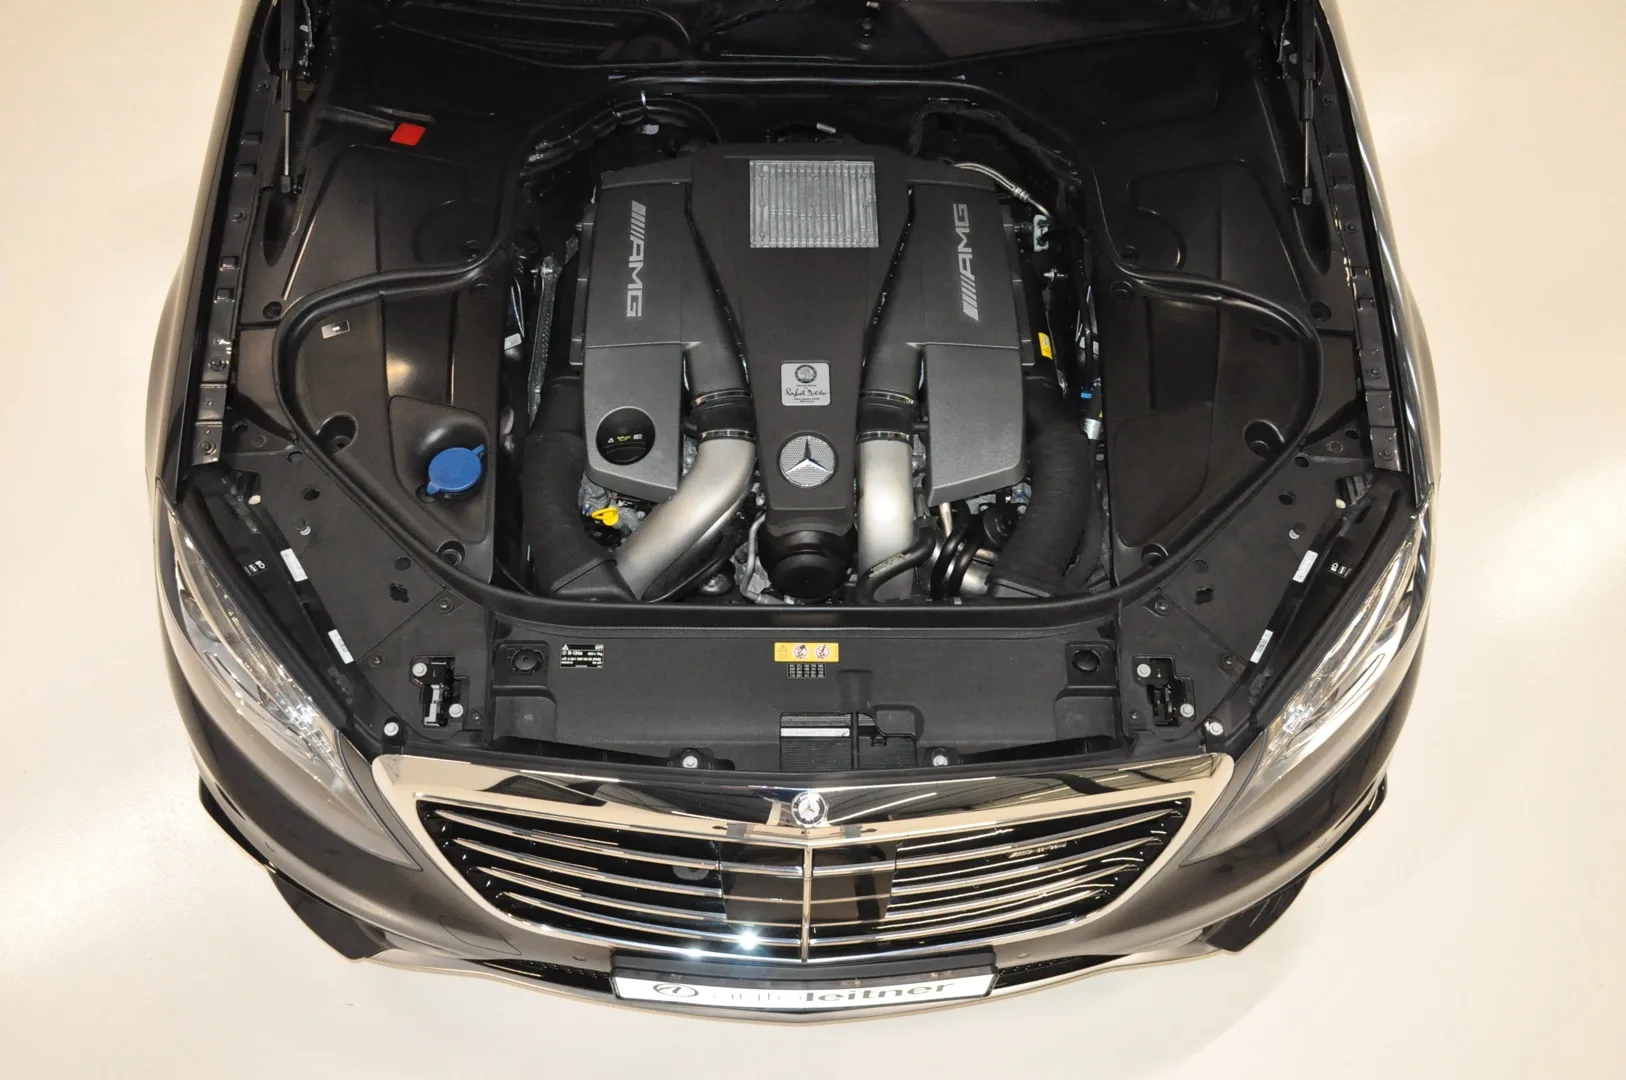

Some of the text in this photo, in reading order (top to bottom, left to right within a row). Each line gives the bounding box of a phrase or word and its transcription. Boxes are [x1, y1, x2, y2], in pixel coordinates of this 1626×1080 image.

[626, 234, 645, 317] AMG
[952, 203, 976, 281] AMG
[712, 983, 955, 1002] utleitner
